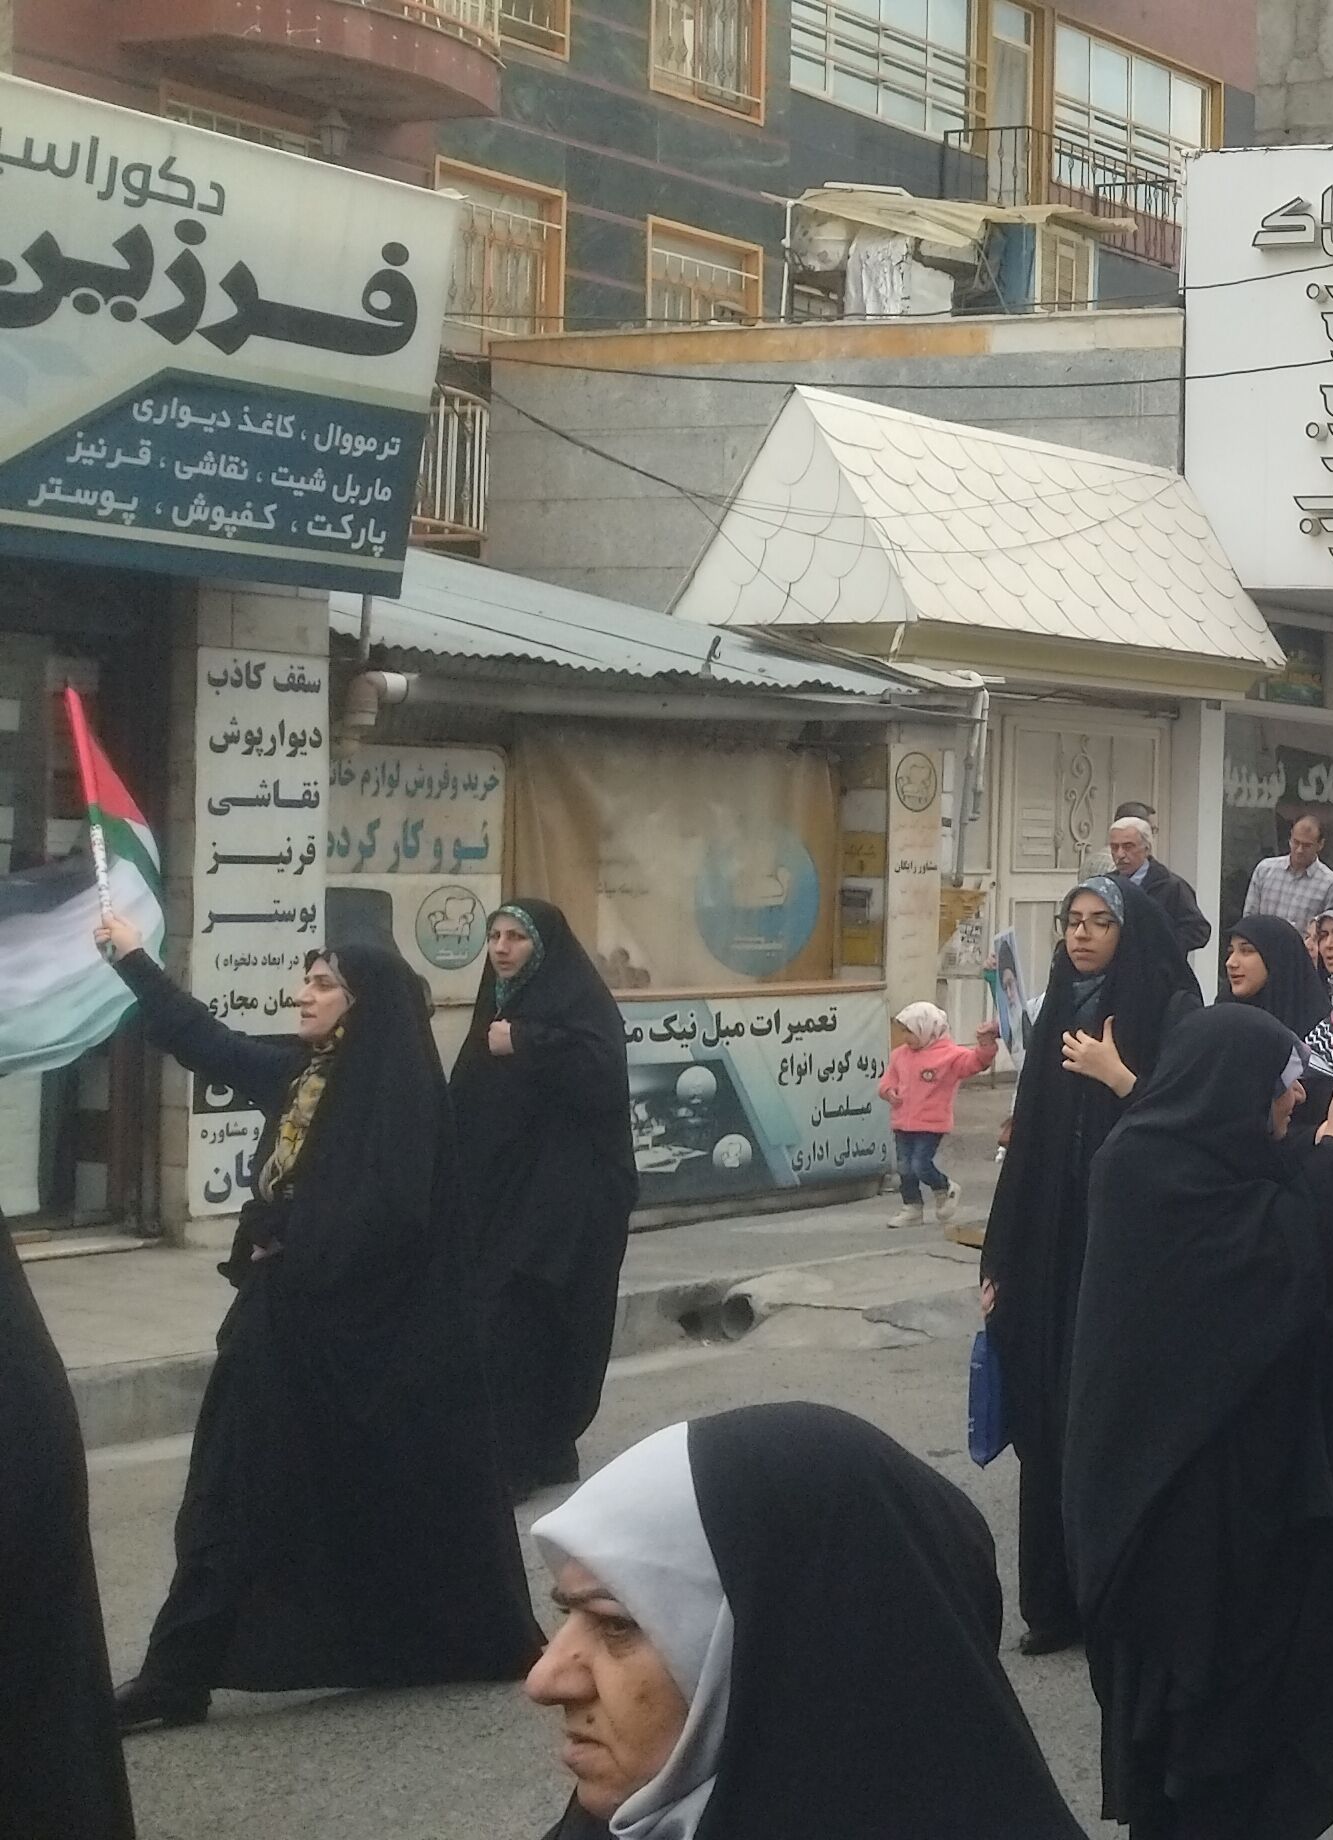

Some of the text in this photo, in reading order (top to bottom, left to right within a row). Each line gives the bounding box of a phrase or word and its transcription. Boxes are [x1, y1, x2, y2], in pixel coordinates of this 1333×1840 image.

[0, 126, 226, 217] دکوراس
[132, 396, 232, 433] دیواری
[238, 405, 296, 440] کاغذ
[66, 430, 152, 469] قرنیز
[173, 450, 250, 481] نقاشی
[270, 464, 328, 498] شیت
[331, 474, 393, 506] ماربل
[27, 475, 139, 526] پوستر
[171, 492, 279, 538] کفپوش
[306, 513, 388, 558] پارکت
[206, 657, 323, 696] سقف کاذب
[208, 715, 324, 758] دیوارپوش
[207, 778, 321, 817] نقاشی
[205, 834, 317, 875] قرنیز
[200, 899, 318, 934] پوستر
[648, 1011, 698, 1048] نیک
[702, 1010, 745, 1048] مبل
[749, 1006, 838, 1044] تعمیرات
[778, 1051, 813, 1086] انواع
[817, 1049, 853, 1083] کوبی
[810, 1095, 872, 1127] مبلمان
[200, 1121, 249, 1144] مشاوره
[791, 1138, 830, 1172] اداری
[833, 1137, 876, 1167] صندلی
